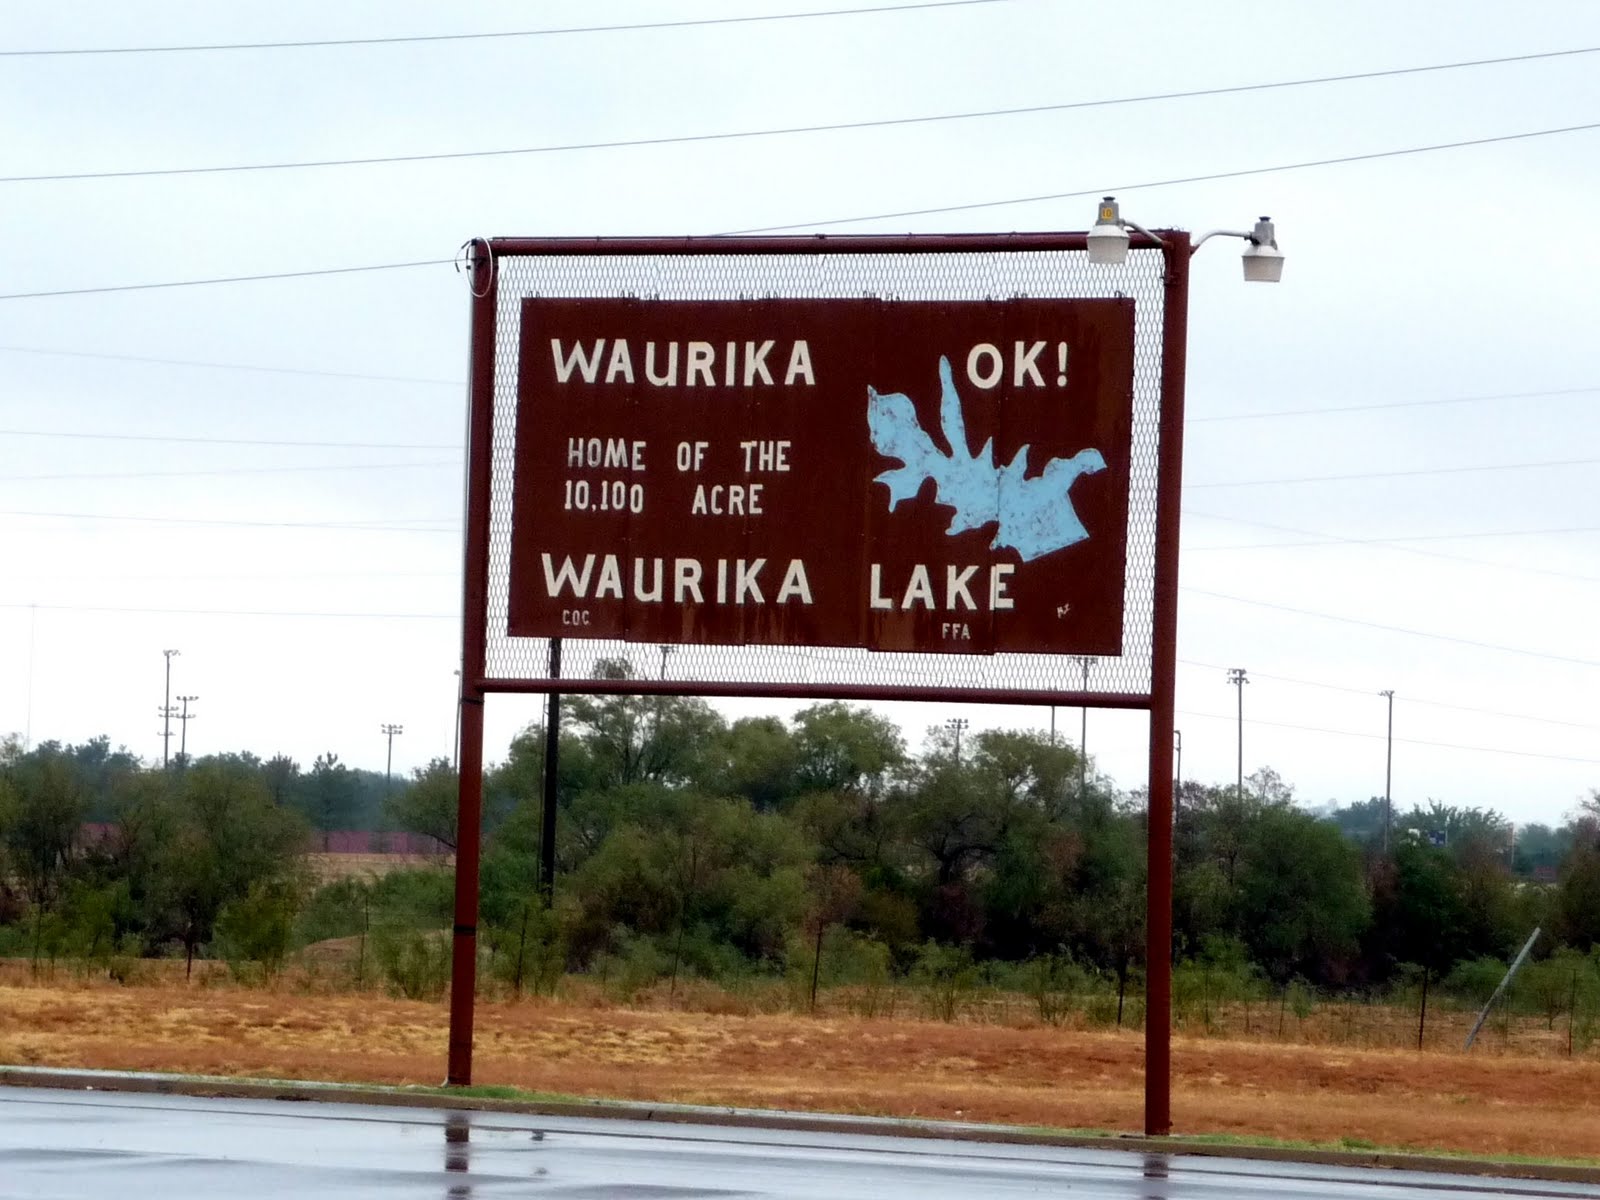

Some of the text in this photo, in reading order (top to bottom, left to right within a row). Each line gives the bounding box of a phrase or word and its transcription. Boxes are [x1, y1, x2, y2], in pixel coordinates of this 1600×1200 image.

[551, 338, 1068, 389] WAURIKA OK!
[568, 437, 791, 472] HOME OF THE
[564, 480, 763, 515] 10,100 ACRE
[541, 552, 1015, 611] WAURIKA LAKE
[562, 609, 590, 626] COC
[942, 622, 971, 640] FFA
